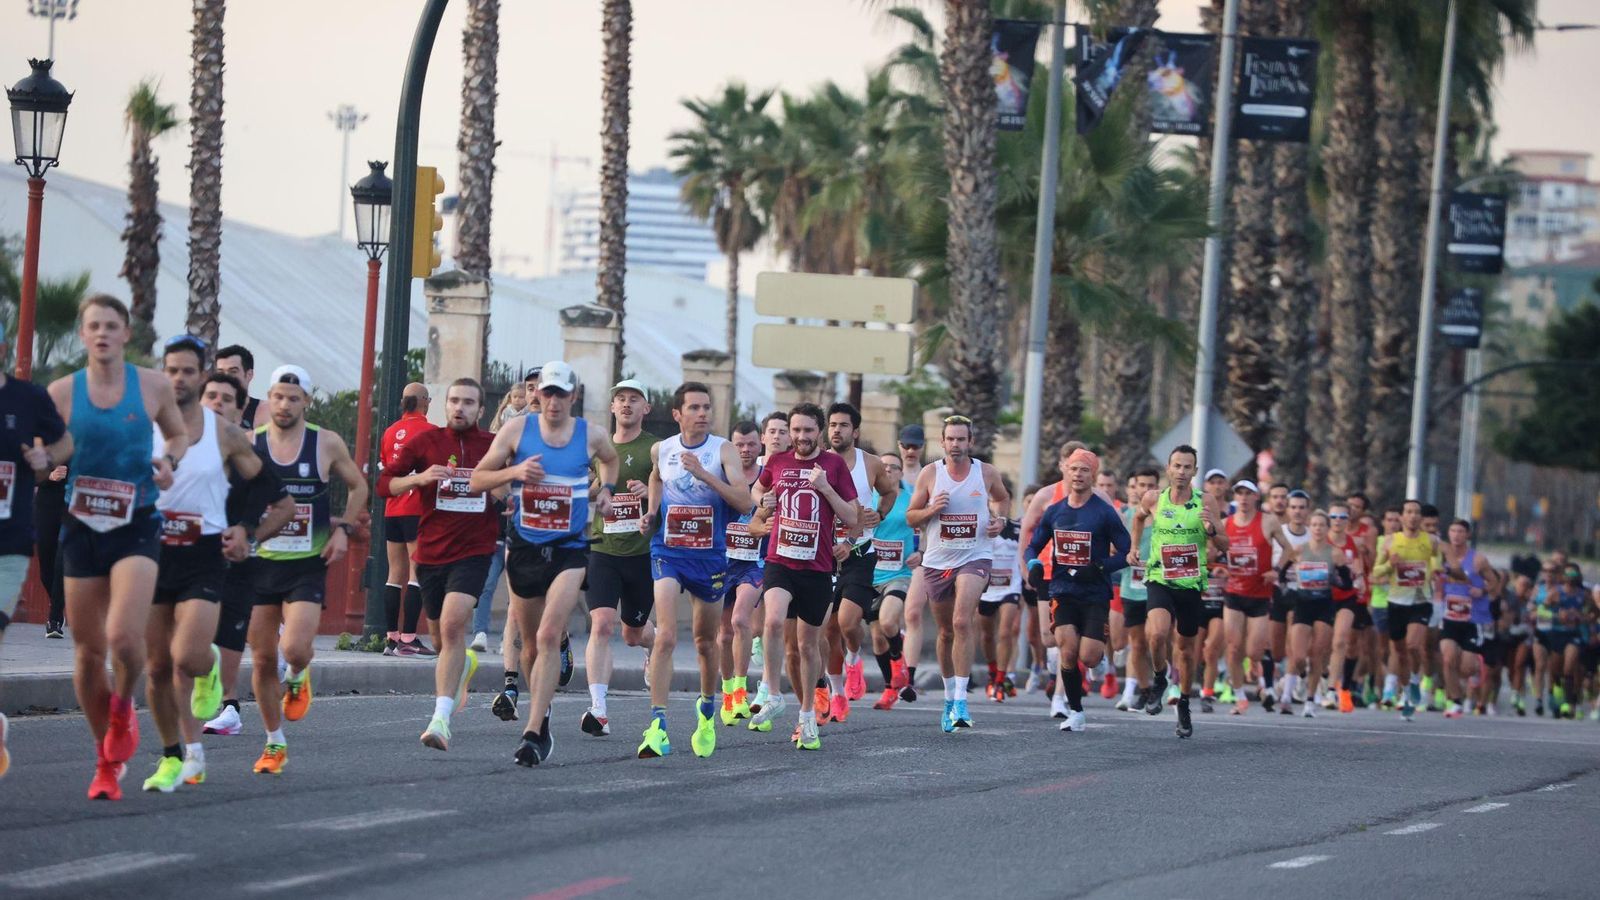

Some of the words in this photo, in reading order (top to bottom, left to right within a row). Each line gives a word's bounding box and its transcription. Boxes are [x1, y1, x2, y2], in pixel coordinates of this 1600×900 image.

[85, 495, 119, 511] 14864
[533, 499, 559, 510] 1696
[778, 488, 820, 522] 10
[678, 507, 711, 515] GENERALI
[680, 520, 699, 530] 750
[946, 526, 971, 535] 16934
[731, 535, 755, 546] 12955
[785, 531, 810, 543] 12728
[1062, 542, 1081, 551] 6101
[1170, 556, 1189, 565] 7661
